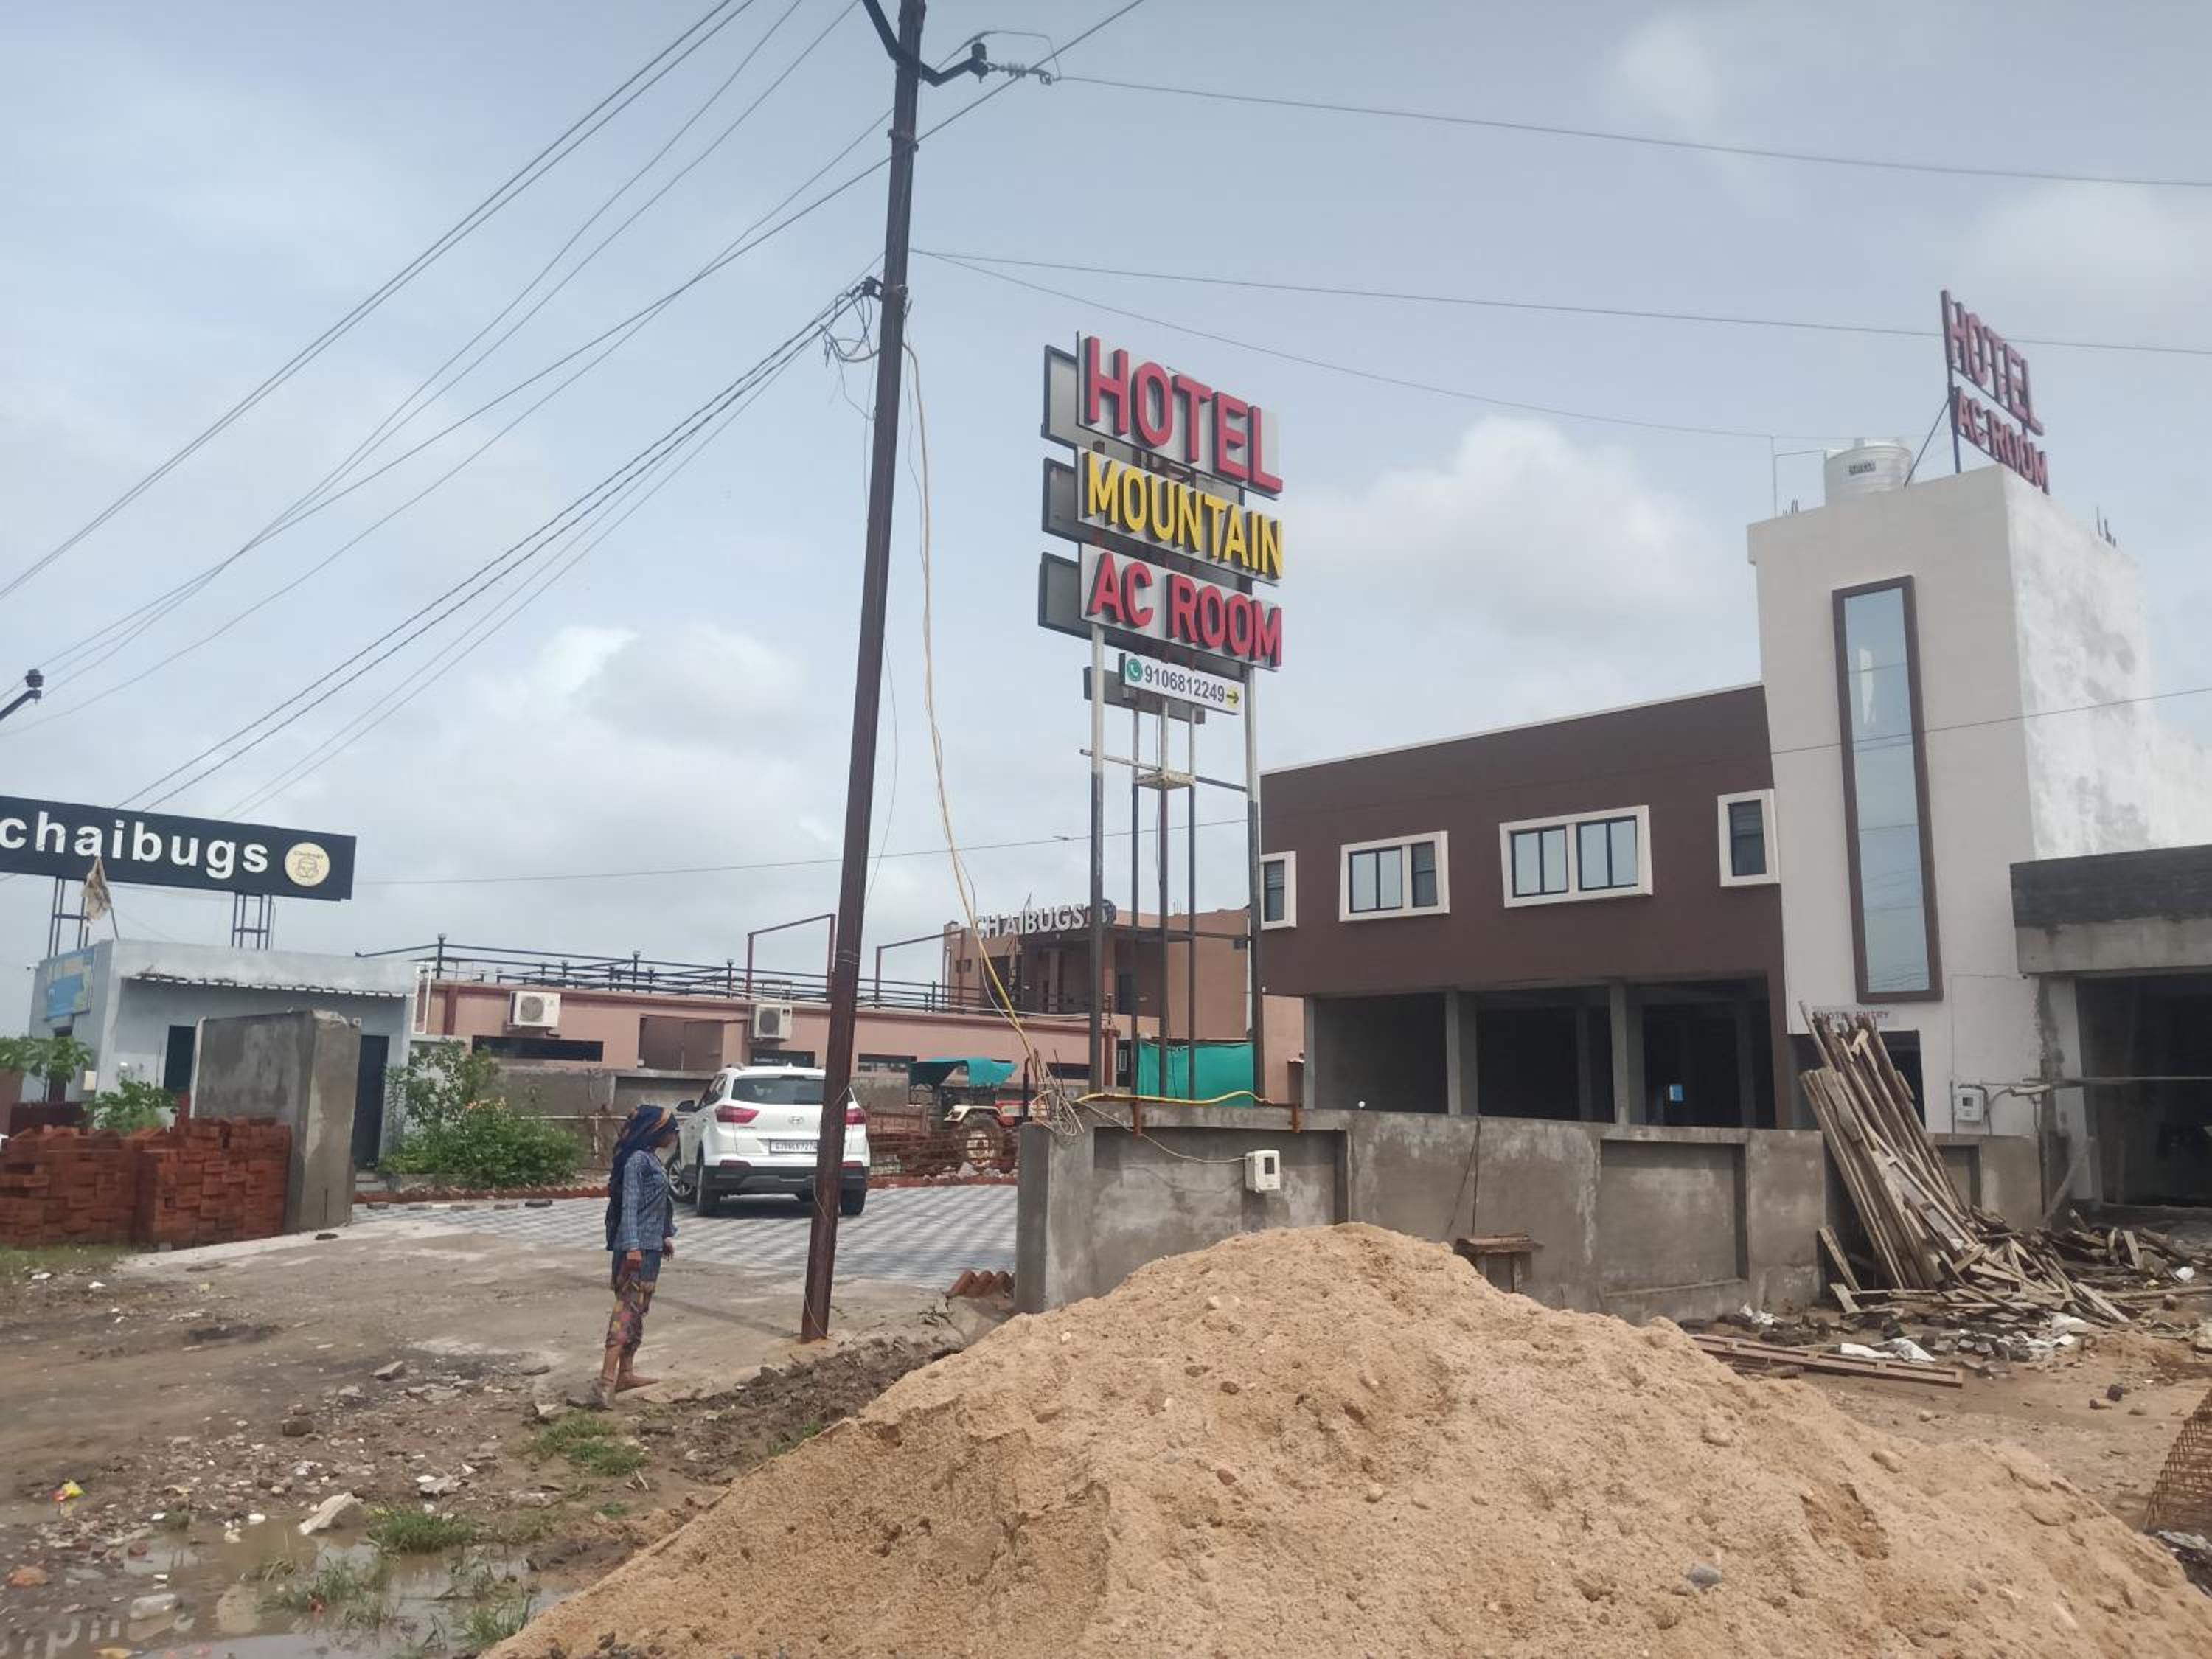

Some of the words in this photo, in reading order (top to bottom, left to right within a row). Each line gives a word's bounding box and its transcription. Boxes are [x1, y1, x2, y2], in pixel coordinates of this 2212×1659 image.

[1084, 336, 1283, 494] HOTEL
[1941, 291, 2044, 436] HOTEL
[1952, 386, 1987, 448] AC
[1986, 409, 2050, 495] ROOM
[1083, 451, 1283, 580] MOUNTAIN
[1086, 552, 1154, 628] AC
[1166, 573, 1282, 667] ROOM
[1145, 665, 1225, 703] 9106812249
[0, 811, 268, 880] chaibugs
